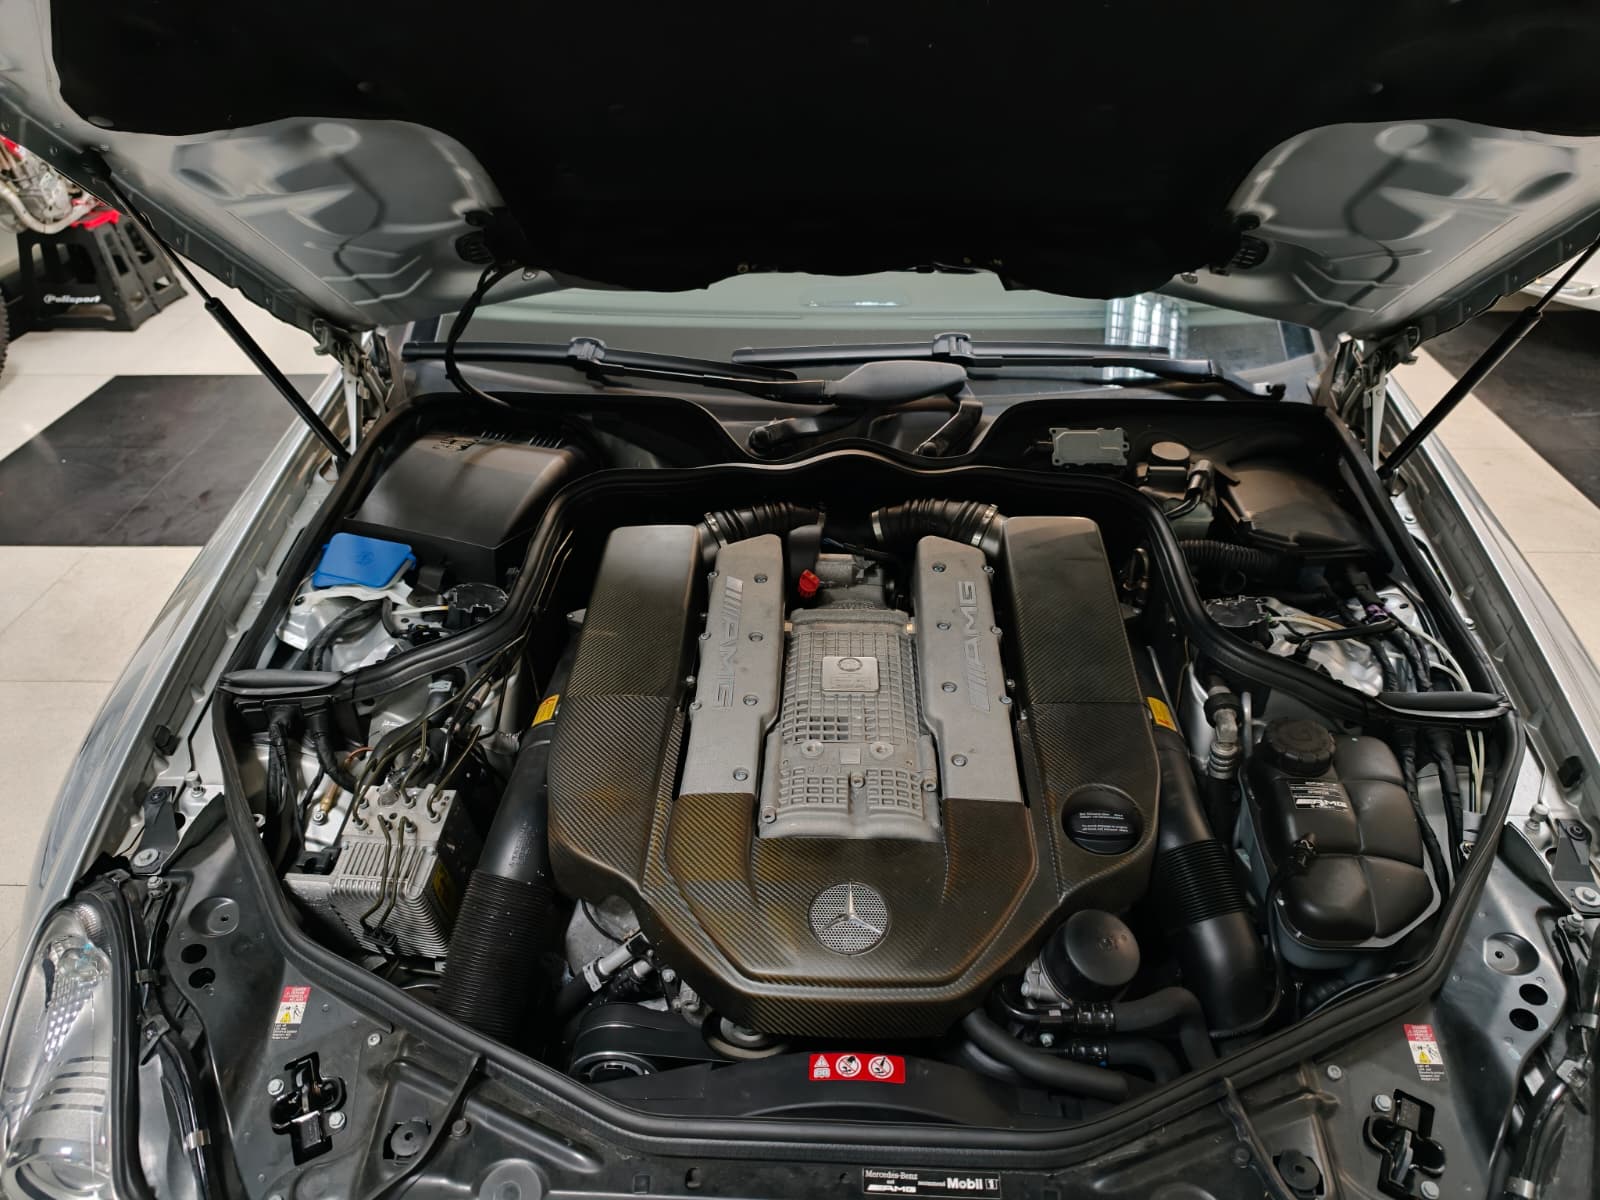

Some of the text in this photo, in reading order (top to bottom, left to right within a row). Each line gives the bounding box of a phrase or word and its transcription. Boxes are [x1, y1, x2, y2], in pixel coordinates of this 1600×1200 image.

[959, 581, 984, 677] AMG
[712, 603, 742, 711] AMG
[865, 1169, 918, 1180] Mercedes-Benz
[946, 1177, 983, 1190] Mobil
